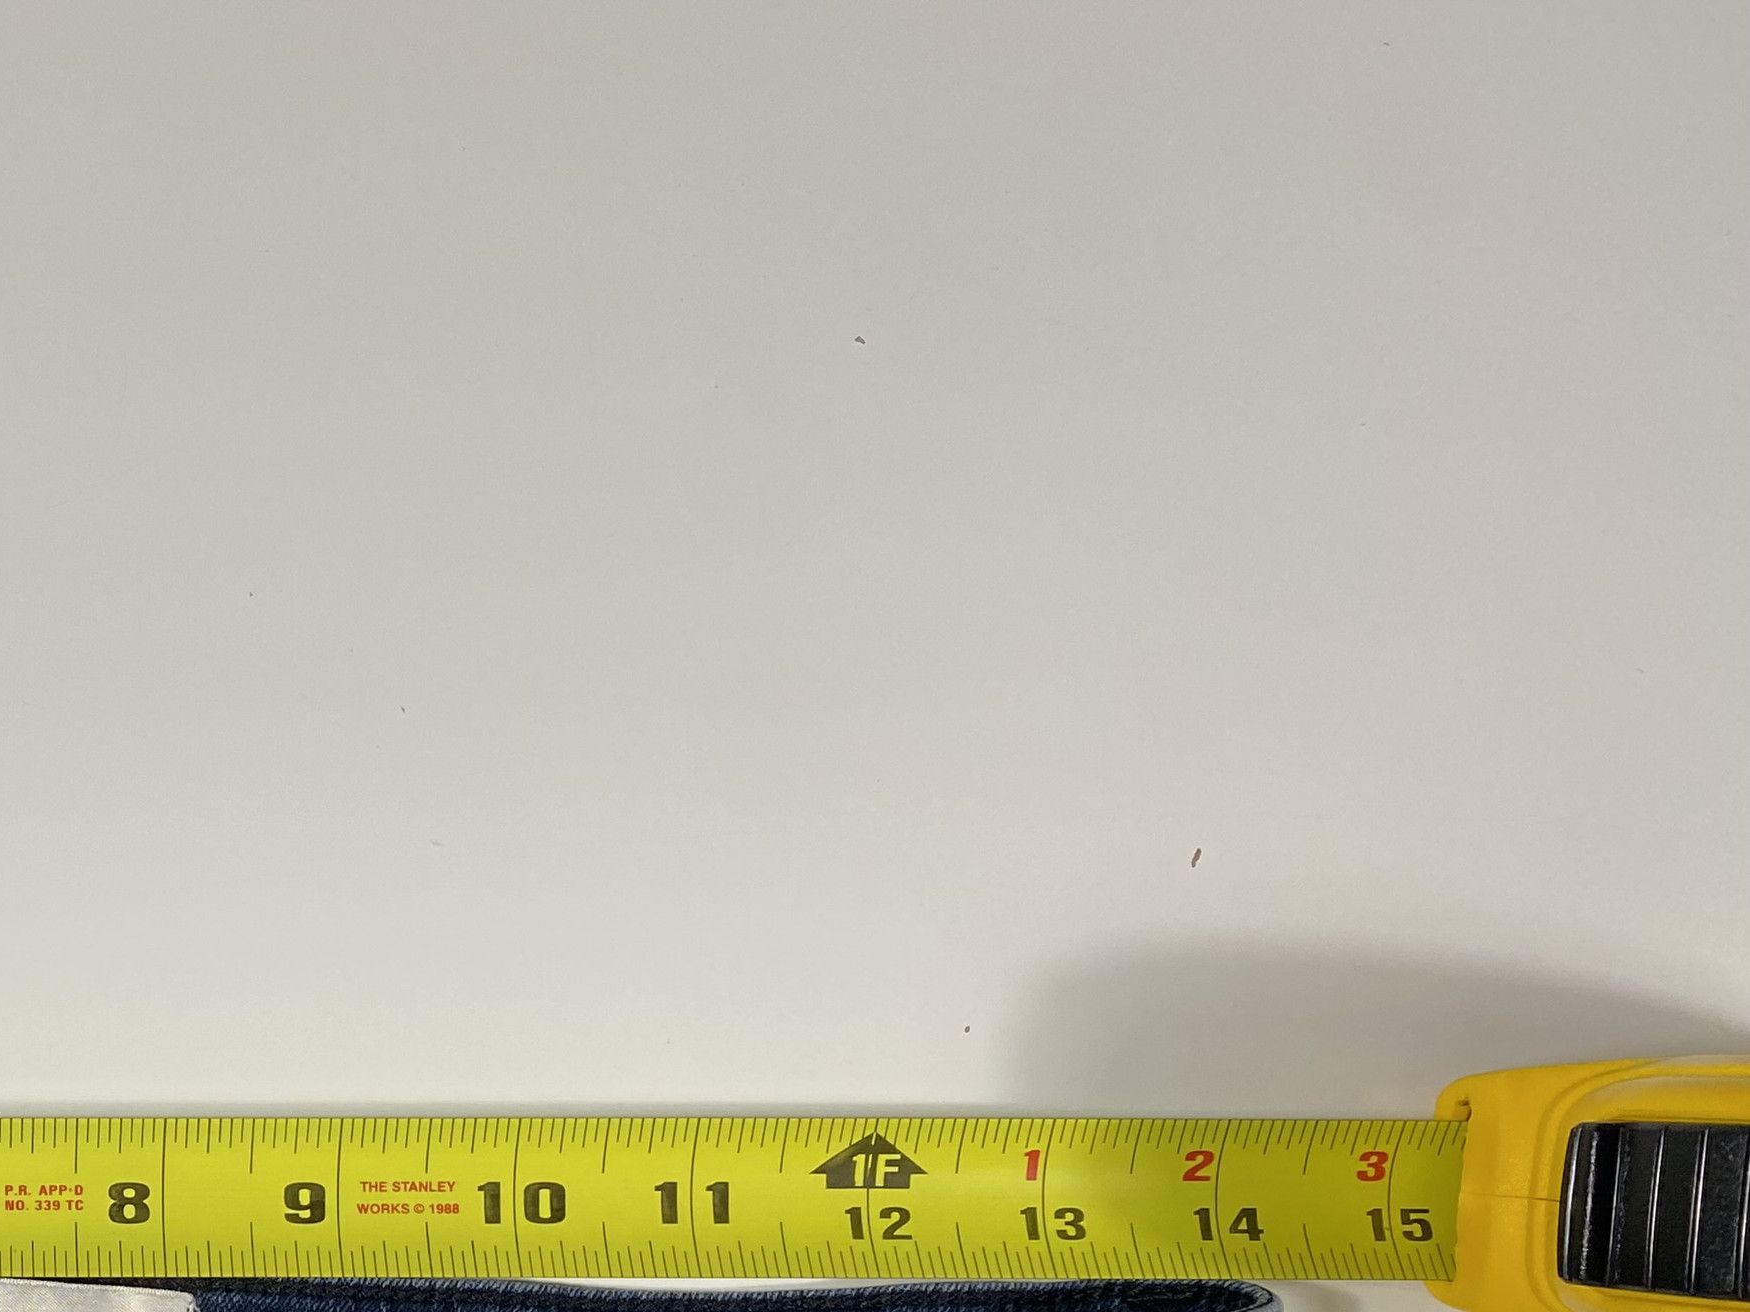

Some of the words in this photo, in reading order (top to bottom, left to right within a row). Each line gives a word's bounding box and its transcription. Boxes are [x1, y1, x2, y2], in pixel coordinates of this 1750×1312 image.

[851, 1153, 902, 1187] 1F
[1024, 1149, 1042, 1182] 1
[1182, 1150, 1215, 1182] 2
[1355, 1150, 1389, 1183] 3
[4, 1184, 32, 1197] P.R.
[107, 1181, 152, 1225] 8
[283, 1181, 328, 1225] 9
[359, 1180, 387, 1193] THE
[391, 1180, 456, 1193] STANLEY
[476, 1180, 567, 1225] 10
[653, 1180, 731, 1225] 11
[4, 1199, 30, 1211] NO.
[34, 1199, 61, 1211] 339
[65, 1199, 84, 1211] TC
[356, 1202, 410, 1215] WORKS
[428, 1202, 460, 1215] 1988
[844, 1205, 914, 1241] 12
[1019, 1205, 1087, 1242] 13
[1193, 1206, 1266, 1243] 14
[1365, 1207, 1435, 1243] 15
